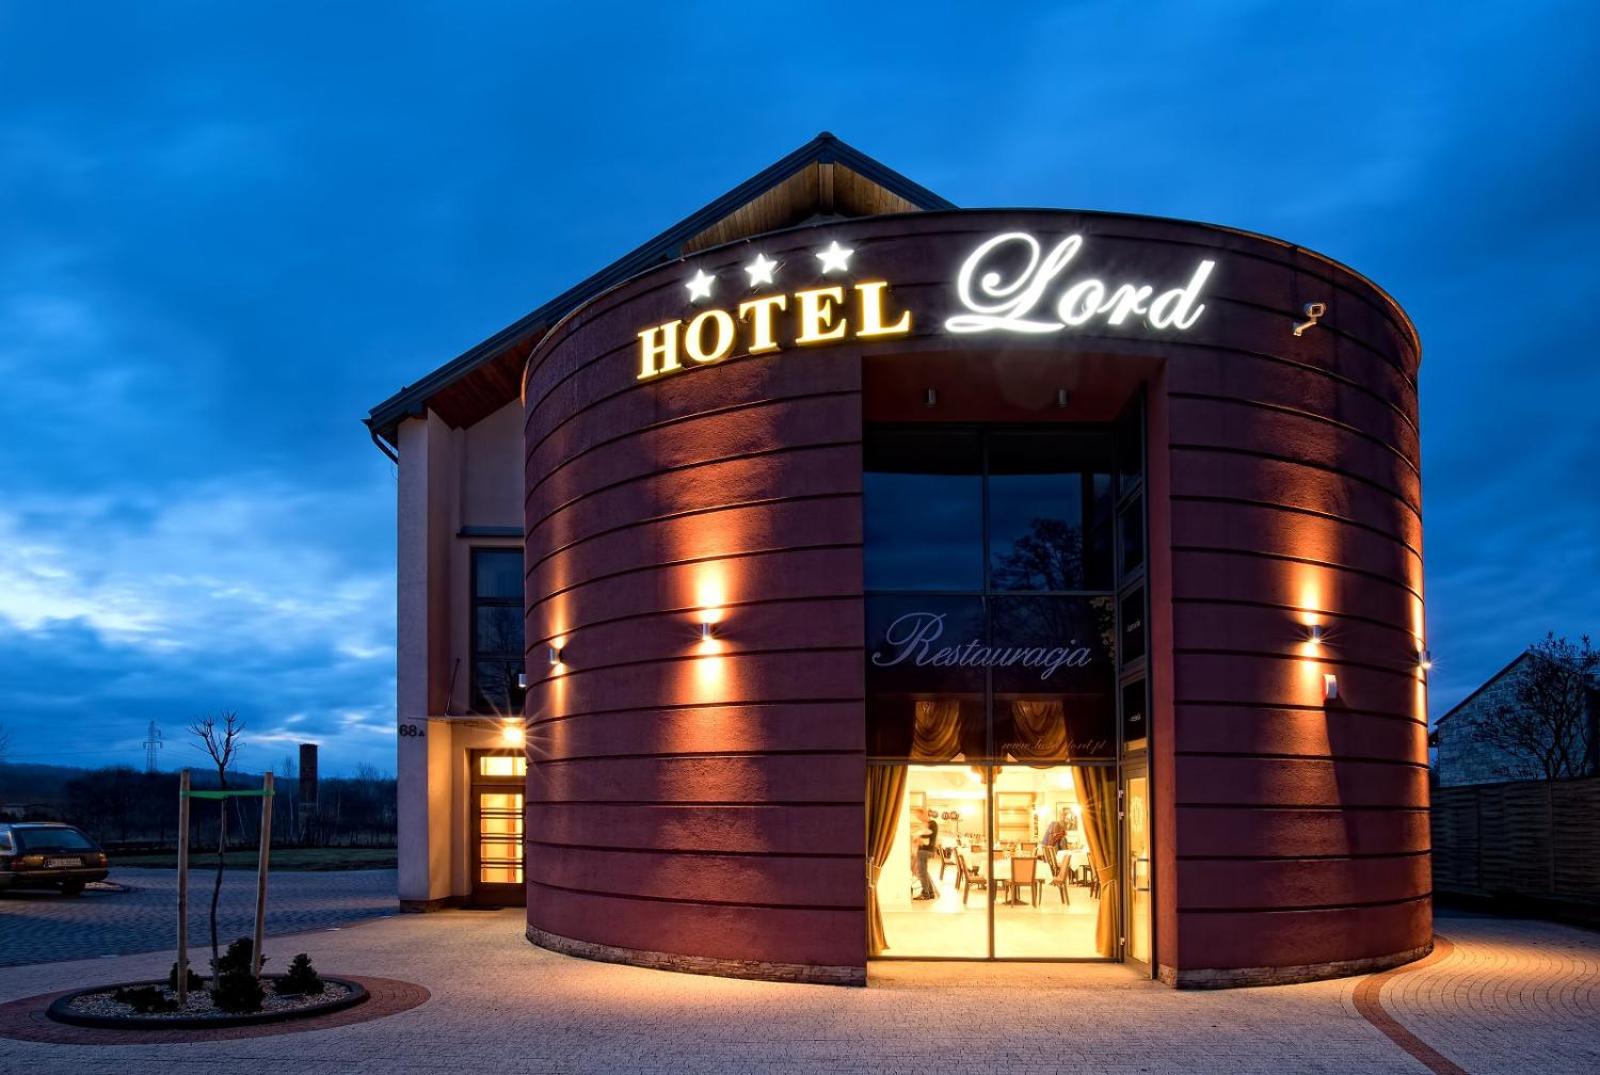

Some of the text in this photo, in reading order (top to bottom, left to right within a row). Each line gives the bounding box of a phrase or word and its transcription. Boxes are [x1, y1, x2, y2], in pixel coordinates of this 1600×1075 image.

[636, 231, 1217, 382] HOTEL Lord
[871, 612, 1093, 681] Restauracja
